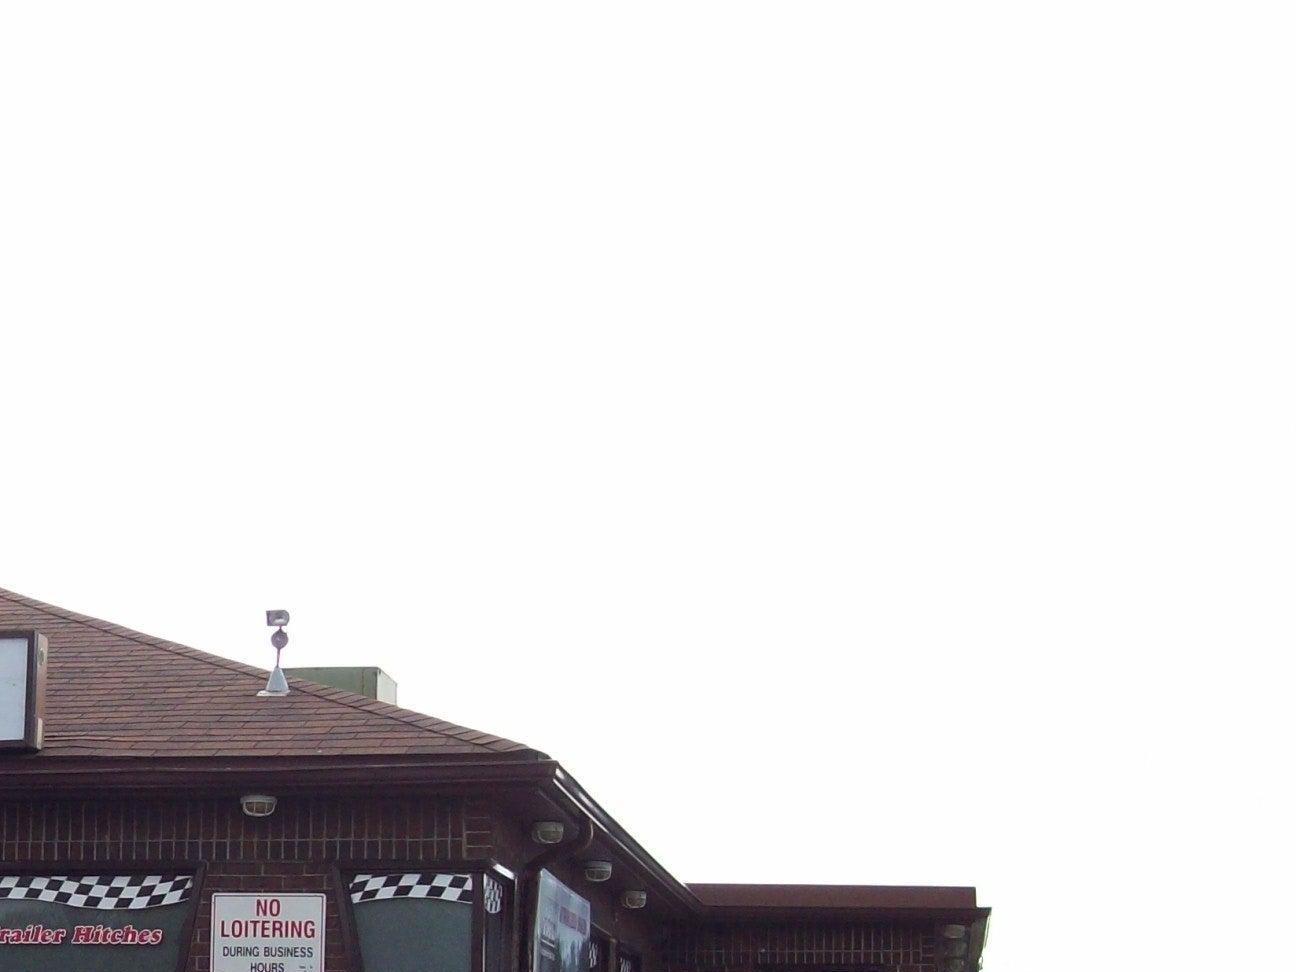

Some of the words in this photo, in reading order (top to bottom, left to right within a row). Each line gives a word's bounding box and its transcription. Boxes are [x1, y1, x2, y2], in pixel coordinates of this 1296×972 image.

[255, 899, 281, 917] NO
[71, 925, 162, 944] Hitches
[220, 920, 316, 939] LOITERING
[222, 946, 260, 958] DURING
[263, 946, 314, 958] BUSINESS
